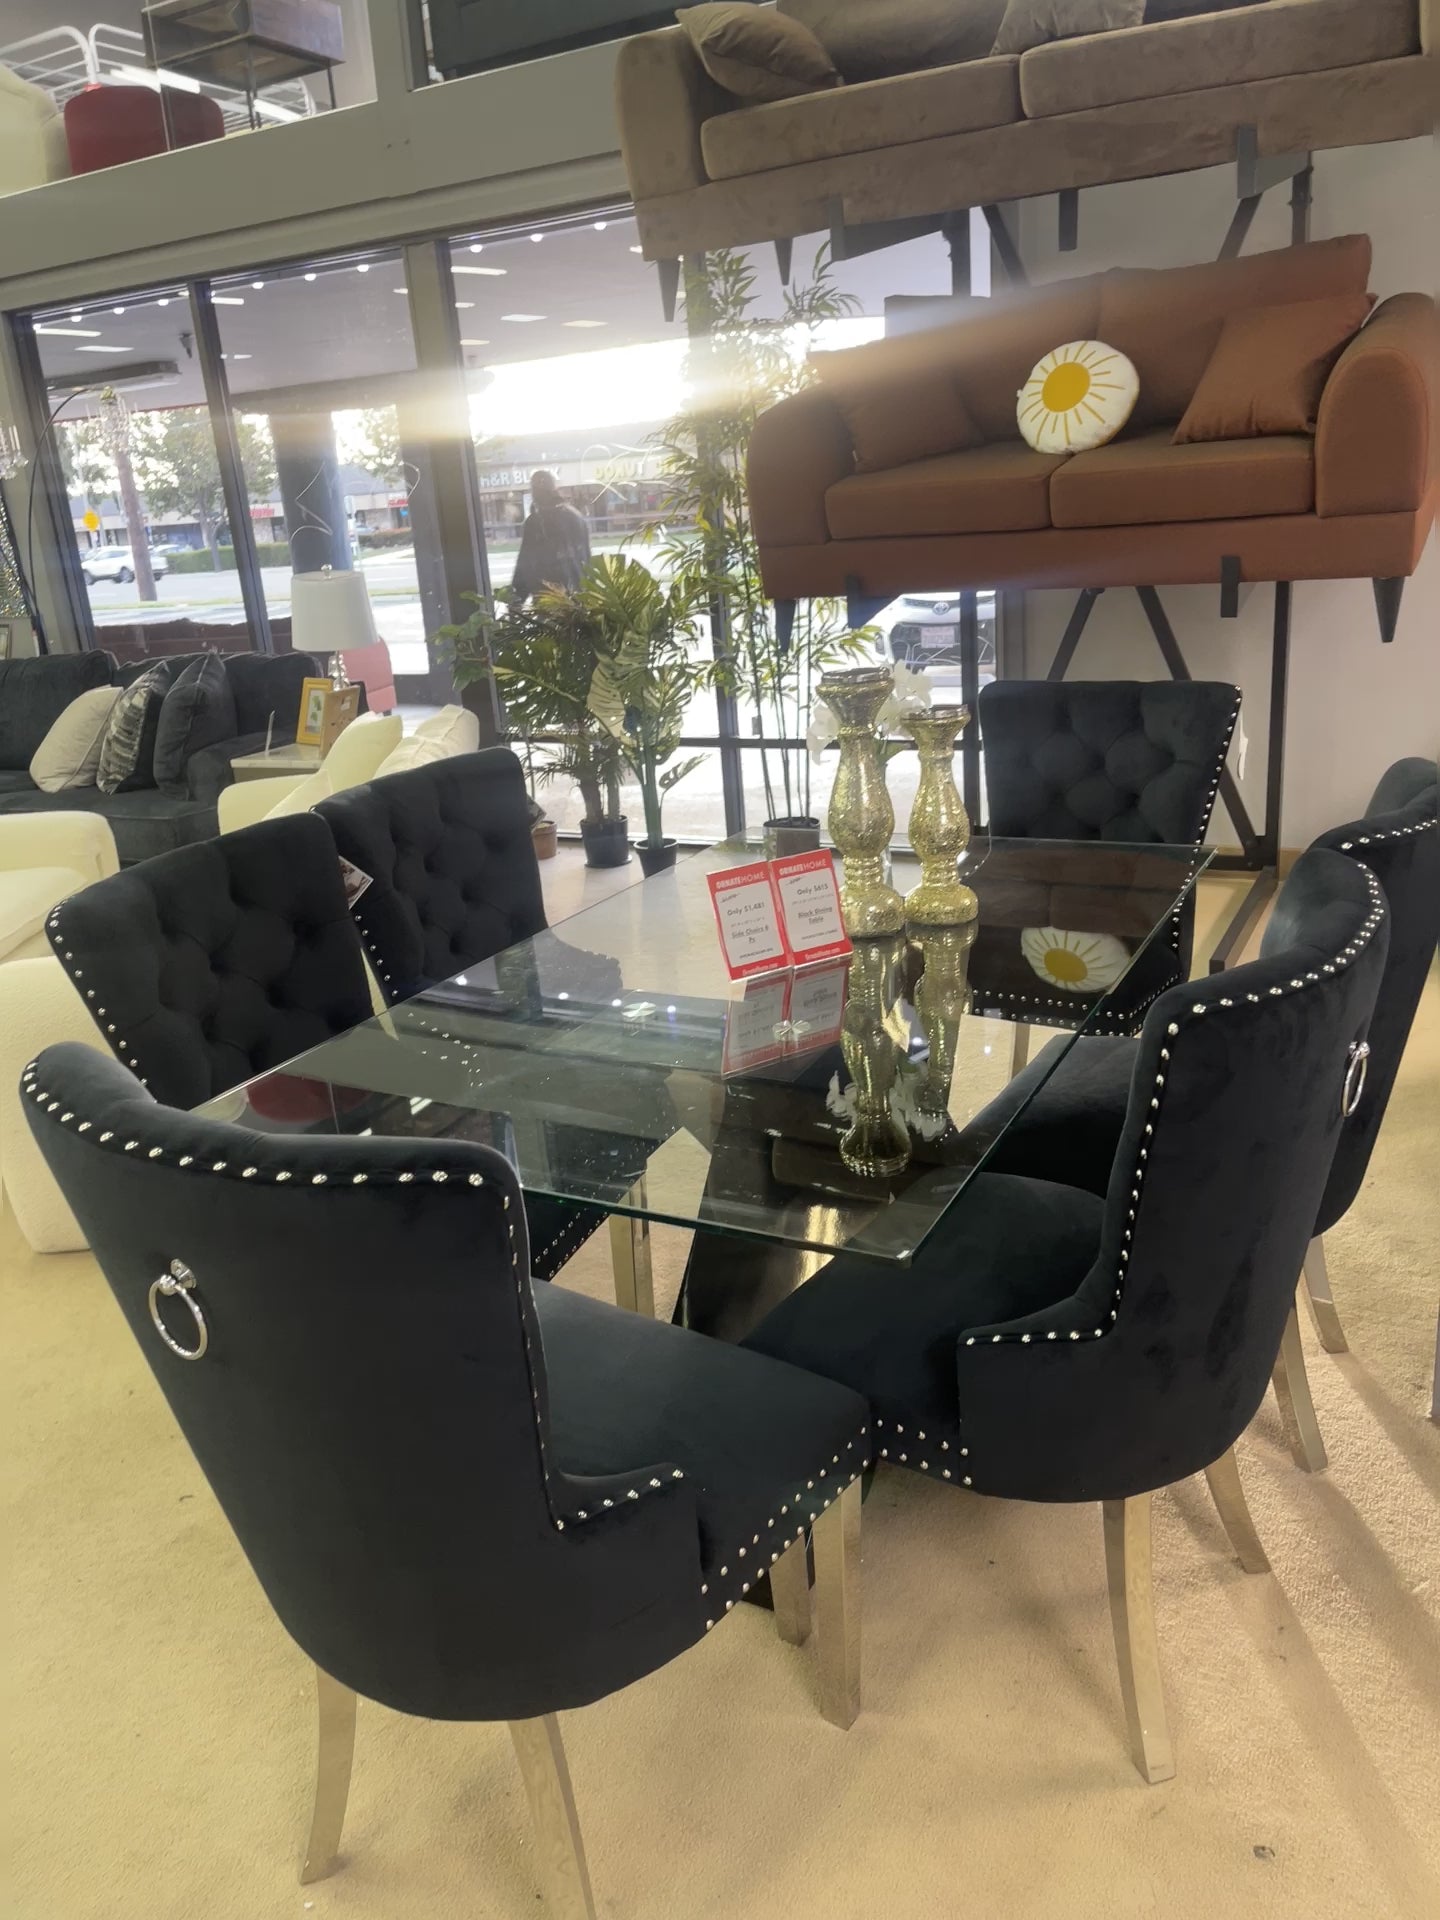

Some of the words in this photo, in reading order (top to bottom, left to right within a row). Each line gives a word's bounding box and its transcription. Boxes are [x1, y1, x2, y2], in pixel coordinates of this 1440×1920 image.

[513, 463, 561, 485] BLK
[797, 887, 812, 896] Only
[727, 907, 743, 917] Only
